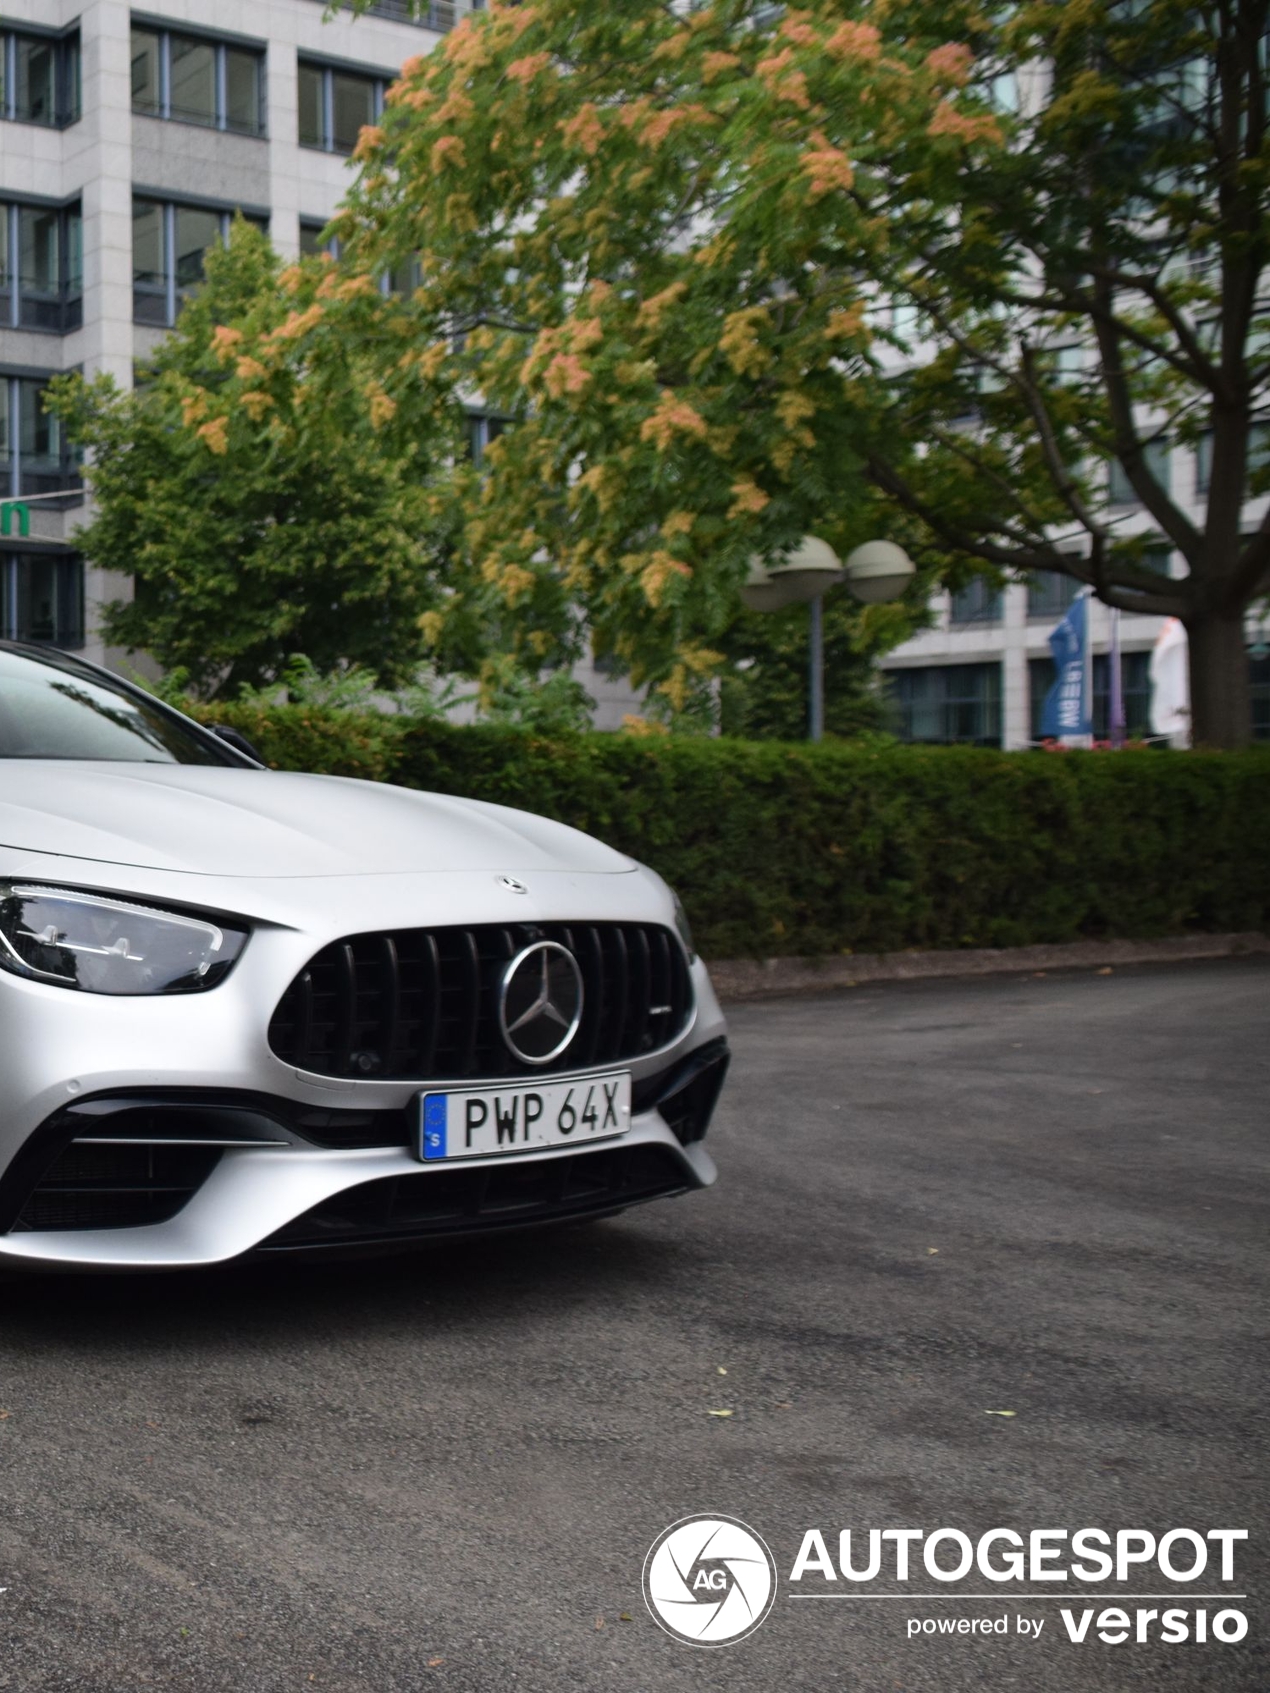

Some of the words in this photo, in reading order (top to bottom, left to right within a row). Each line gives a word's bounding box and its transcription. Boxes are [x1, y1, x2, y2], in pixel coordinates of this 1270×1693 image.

[464, 1092, 544, 1148] PWP
[557, 1081, 619, 1136] 64X
[430, 1133, 440, 1147] S
